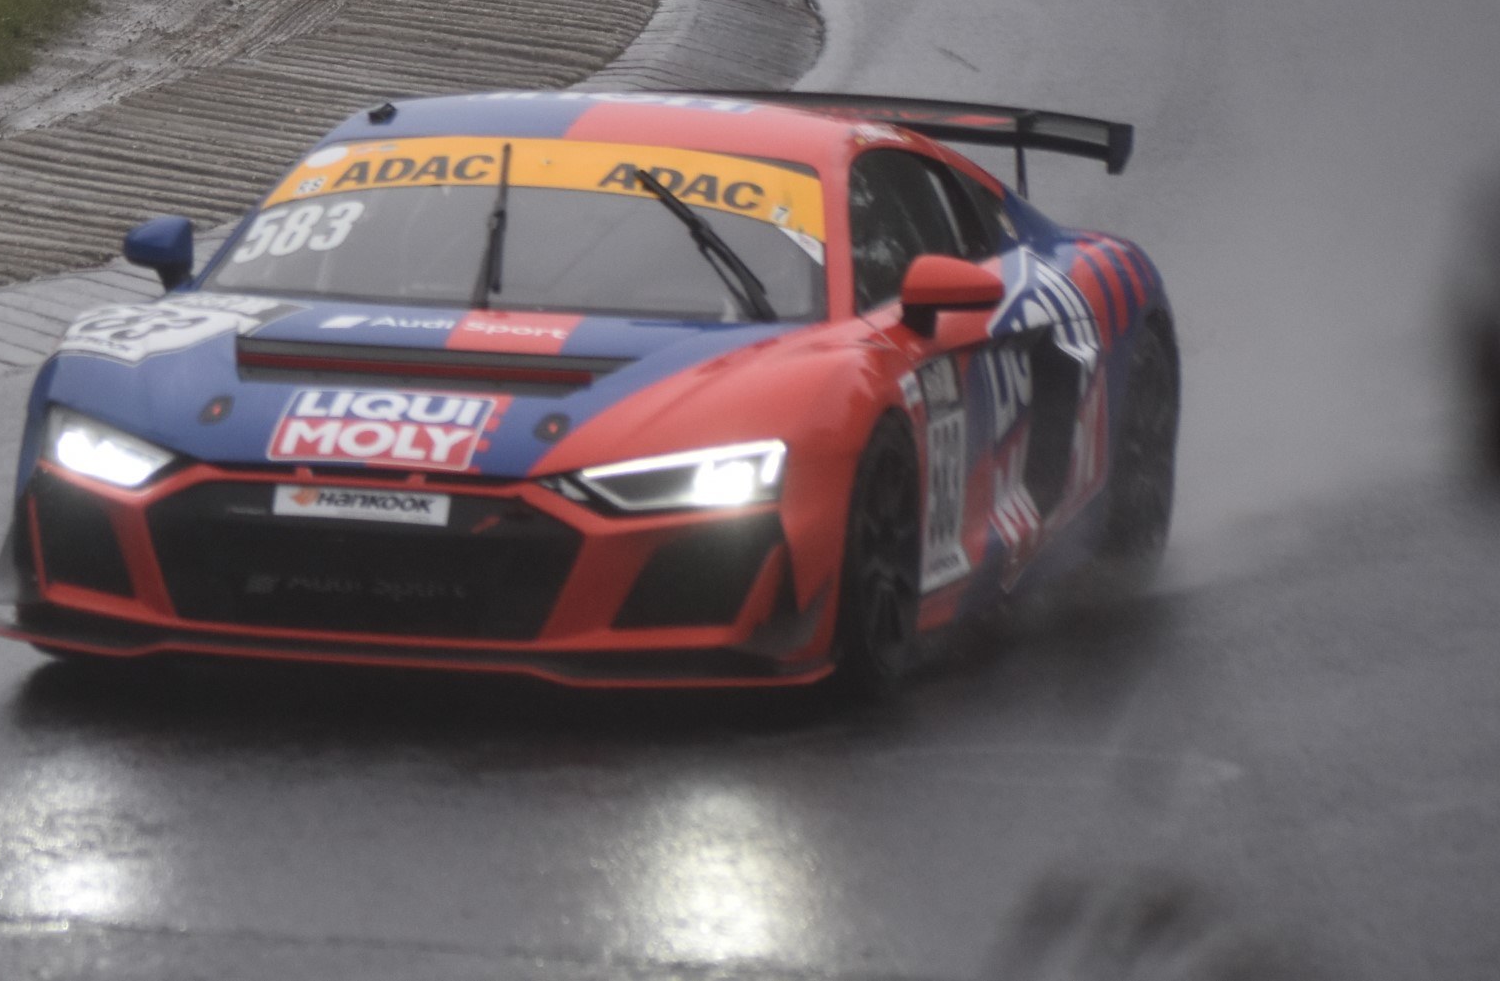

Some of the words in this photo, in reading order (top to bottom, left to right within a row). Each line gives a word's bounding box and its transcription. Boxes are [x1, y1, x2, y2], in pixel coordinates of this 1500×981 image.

[333, 155, 495, 188] ADAC
[599, 162, 763, 209] ADAC
[234, 203, 364, 262] 583
[368, 315, 455, 331] Audi
[462, 319, 568, 341] Sport
[298, 390, 484, 425] LIQUI
[280, 419, 475, 462] MOLY
